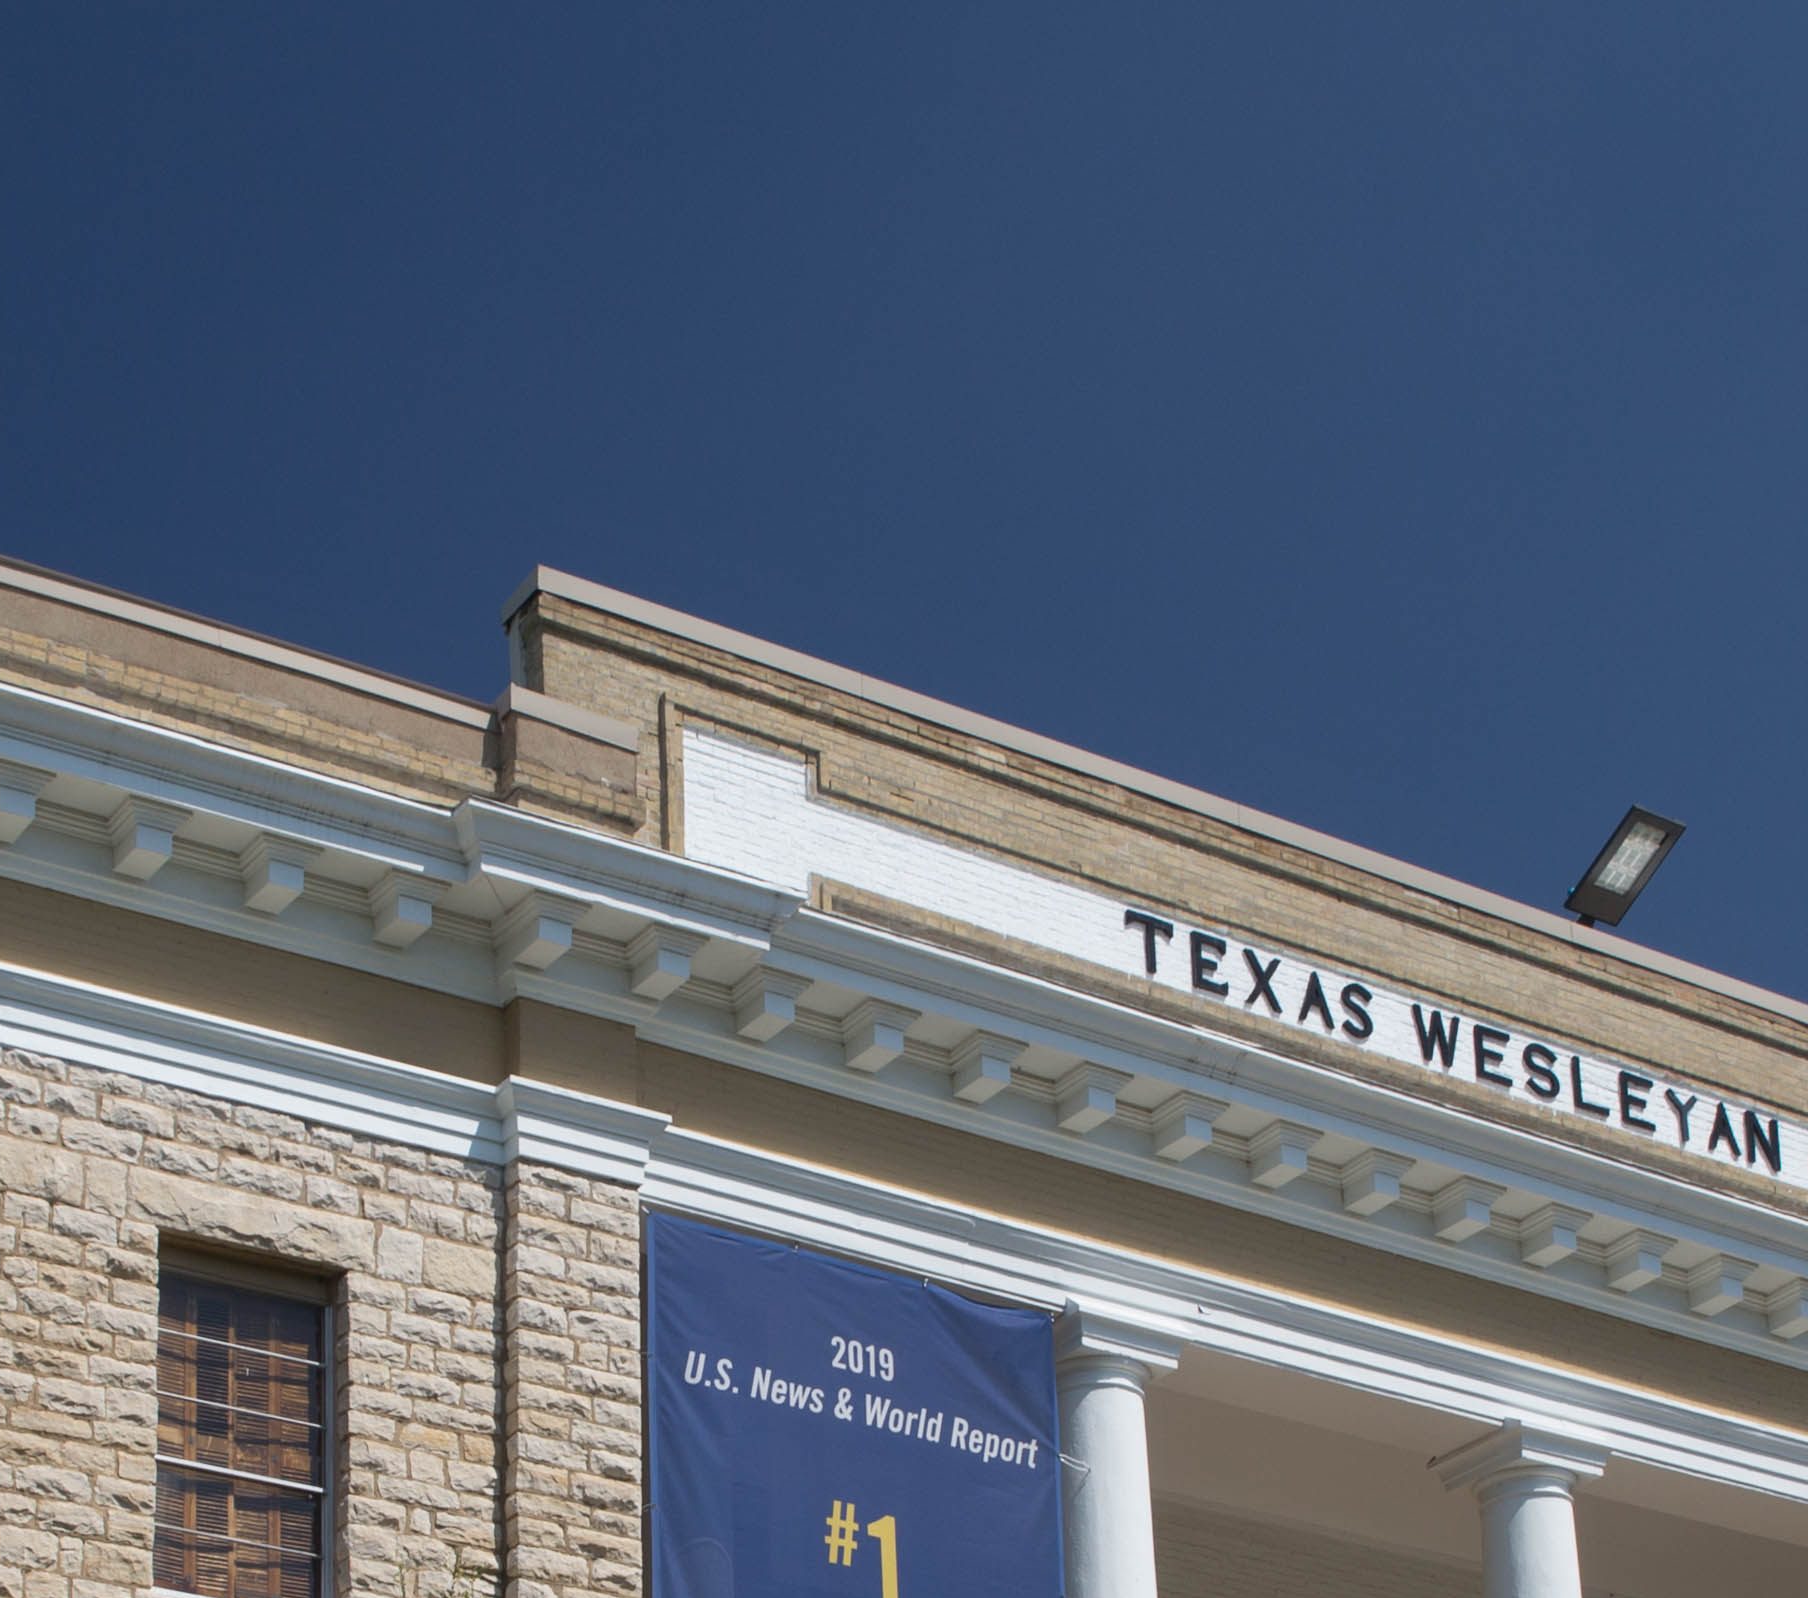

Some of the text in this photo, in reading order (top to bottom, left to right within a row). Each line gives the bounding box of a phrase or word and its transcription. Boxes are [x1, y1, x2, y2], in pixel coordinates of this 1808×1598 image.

[1124, 909, 1373, 1039] TEXAS
[1412, 1003, 1781, 1173] WESLEYAN
[684, 1351, 1039, 1469] U.S. News & World Report
[830, 1336, 895, 1382] 2019
